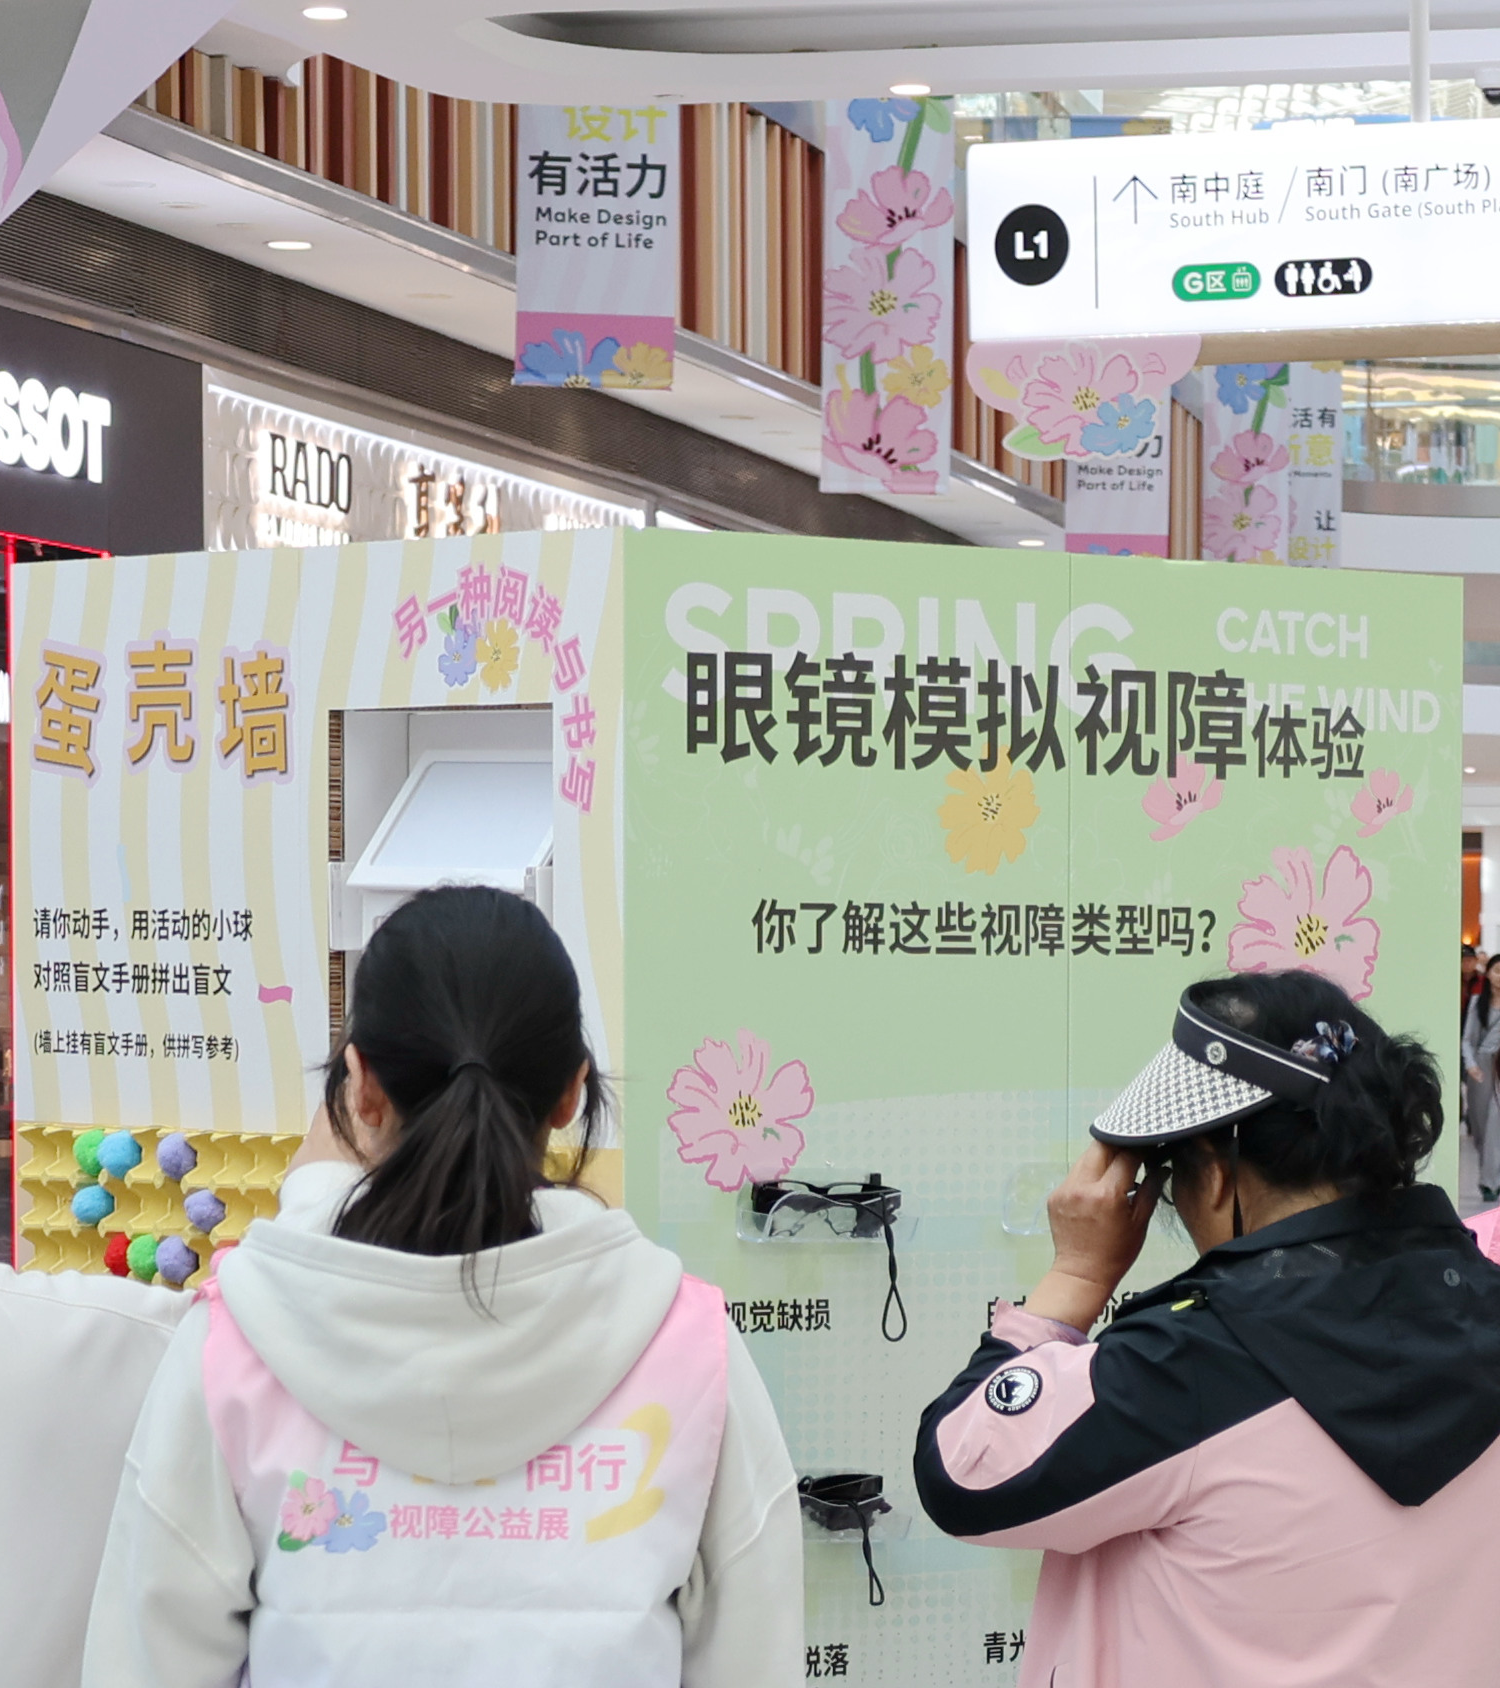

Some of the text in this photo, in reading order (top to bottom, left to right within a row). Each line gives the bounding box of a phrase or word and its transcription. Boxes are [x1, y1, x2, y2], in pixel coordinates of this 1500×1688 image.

[563, 105, 668, 144] 设计
[528, 150, 667, 199] 有活力
[1170, 170, 1265, 205] 南中庭
[1305, 162, 1492, 199] 南门 (南广场)
[535, 207, 668, 230] Make Design
[1169, 208, 1270, 229] South Hub
[1305, 204, 1361, 222] South
[1368, 201, 1413, 219] Gate
[1417, 199, 1476, 220] (South
[535, 230, 654, 249] Part of Life
[1013, 230, 1049, 261] L1
[1183, 270, 1227, 294] G区
[269, 432, 353, 515] RADO
[1077, 464, 1164, 480] Make Design
[1077, 479, 1155, 492] Part of Life
[661, 581, 1137, 722] SPRING
[1215, 606, 1369, 660] CATCH
[391, 564, 595, 815] 另一种阅读与书写
[32, 640, 293, 780] 蛋壳墙
[685, 651, 1367, 781] 眼镜模拟视障体验
[1318, 685, 1443, 735] WIND
[32, 906, 254, 944] 请你动手，用活动的小球
[32, 960, 234, 997] 对照盲文手册拼出盲文
[725, 1298, 831, 1334] 视觉缺损
[524, 1442, 628, 1493] 同行
[388, 1504, 571, 1541] 视障公益展
